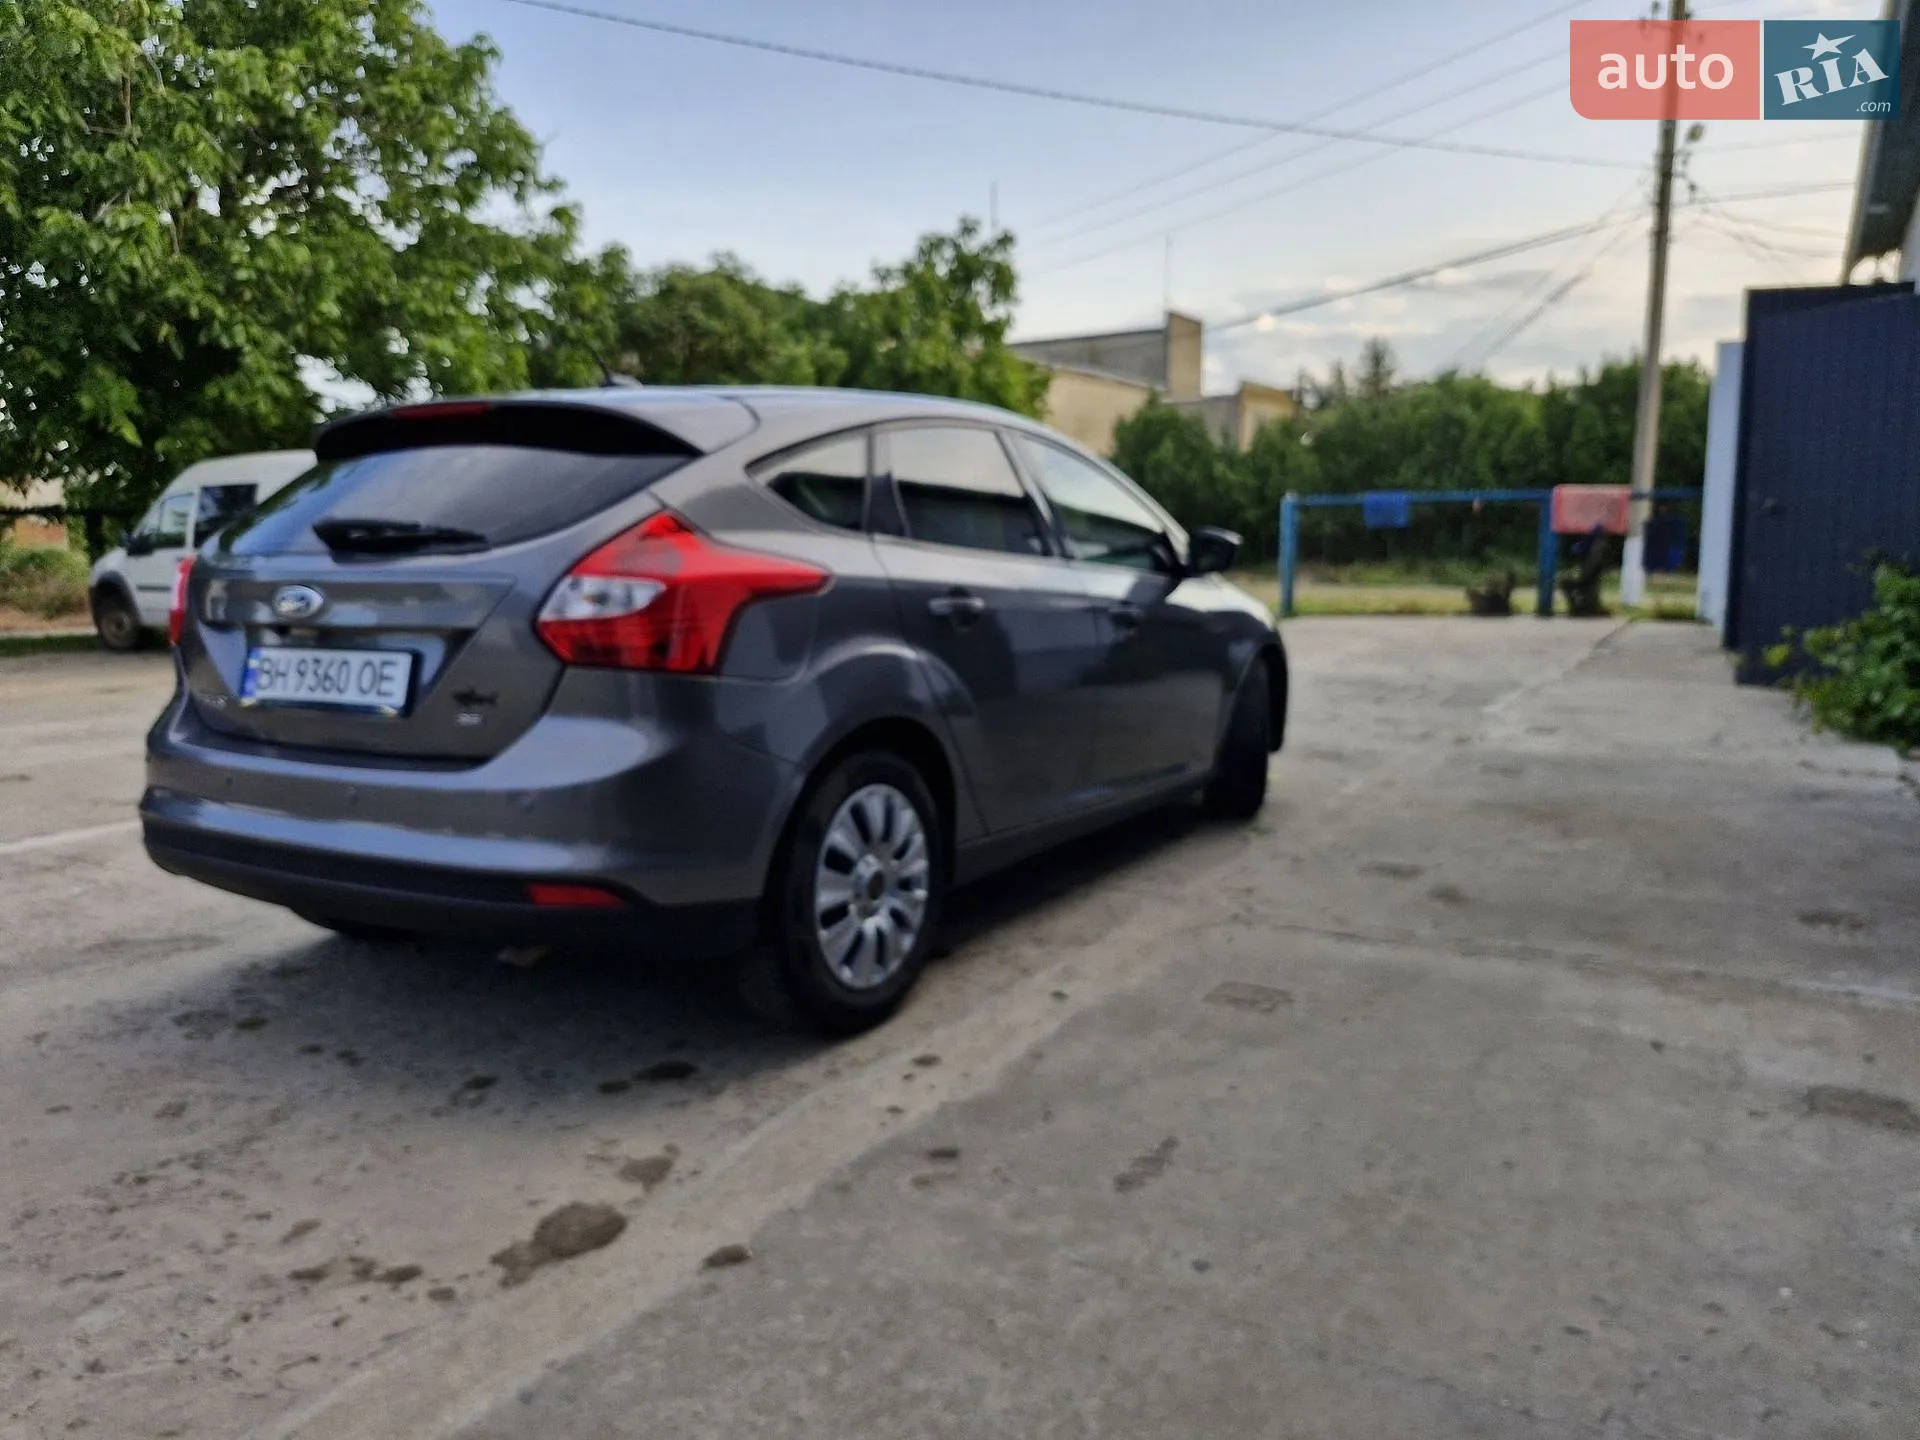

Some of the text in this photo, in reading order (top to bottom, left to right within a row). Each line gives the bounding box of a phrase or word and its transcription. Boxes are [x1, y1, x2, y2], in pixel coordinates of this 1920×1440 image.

[257, 657, 397, 697] BH 9360 OE
